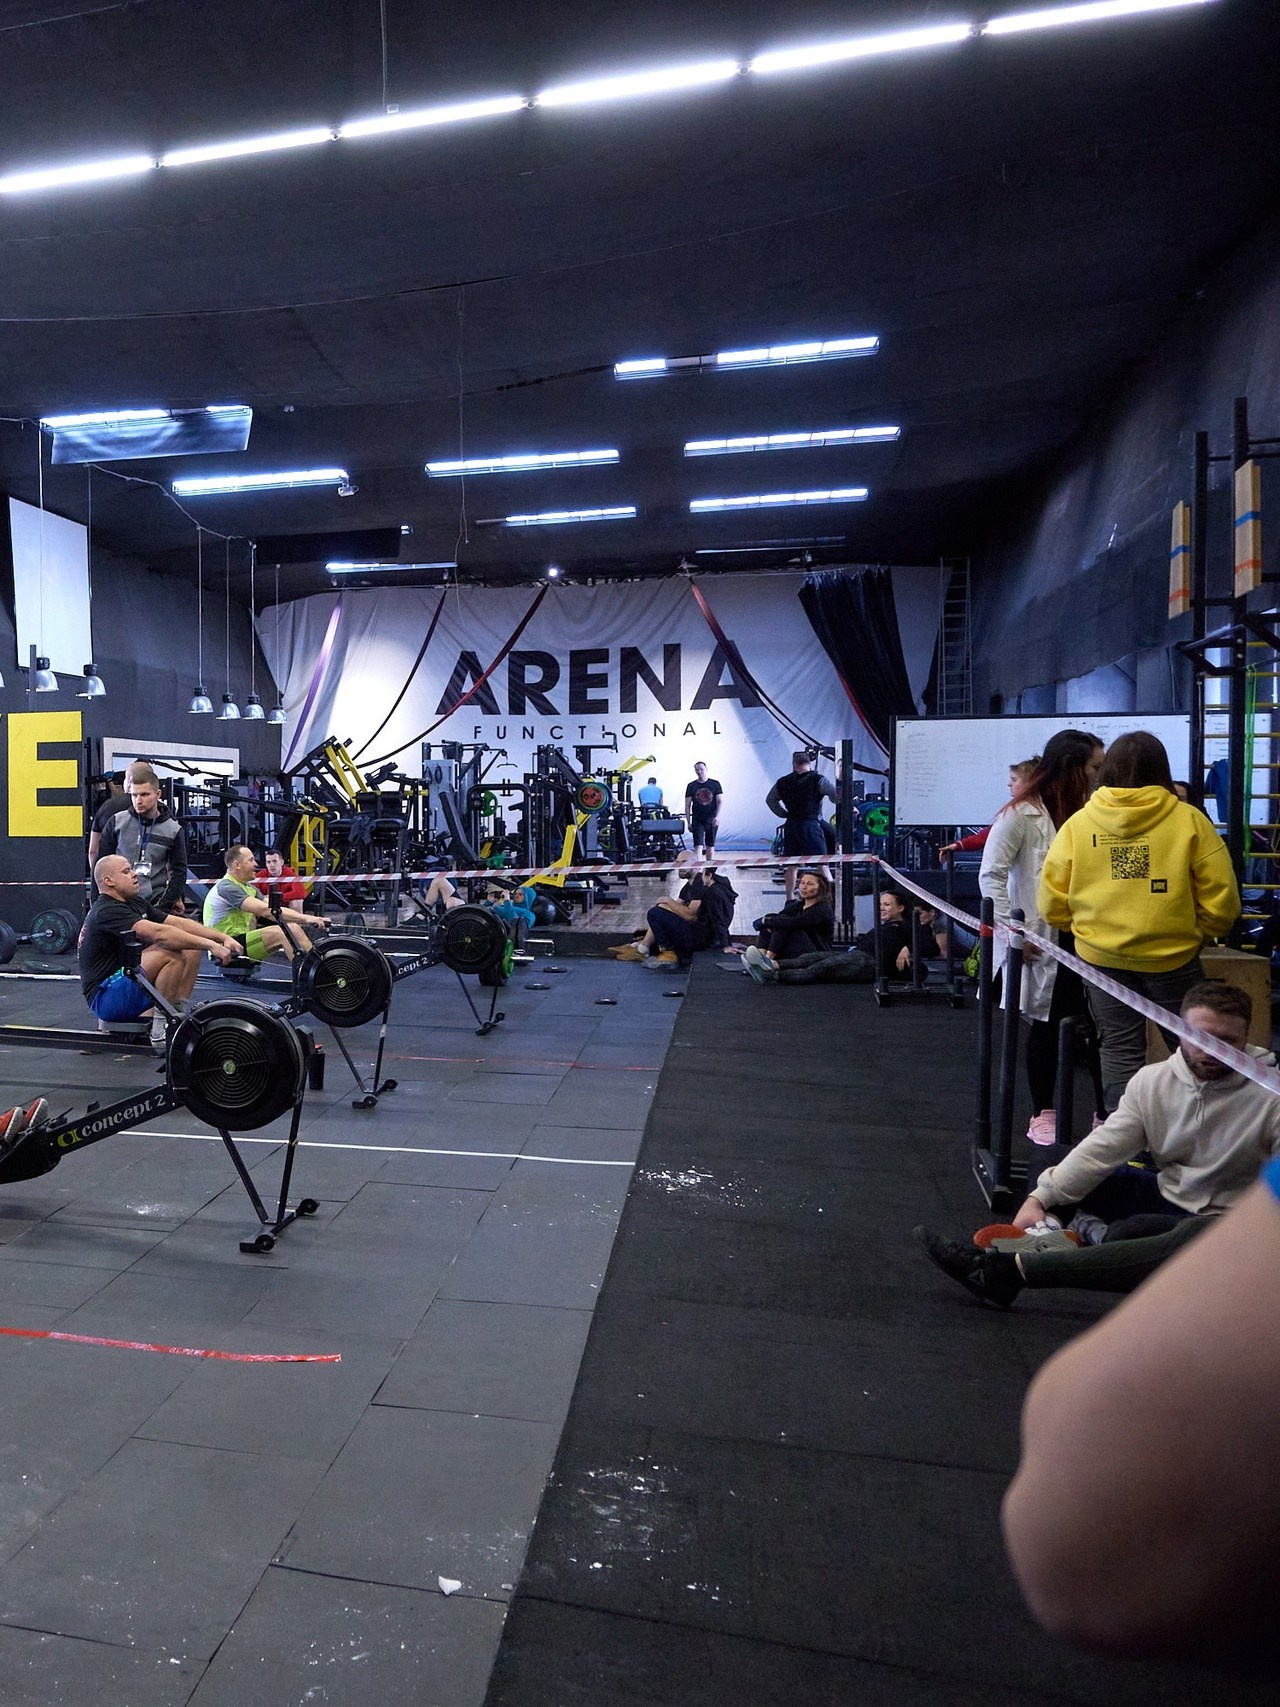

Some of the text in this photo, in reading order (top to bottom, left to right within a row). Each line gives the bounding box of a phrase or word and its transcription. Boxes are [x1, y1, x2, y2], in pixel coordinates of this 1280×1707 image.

[434, 640, 765, 715] ARENA
[473, 721, 721, 740] FUNCTIONAL
[421, 957, 429, 965] 2
[284, 1004, 293, 1014] 2
[81, 1099, 153, 1138] concept
[154, 1094, 166, 1107] 2
